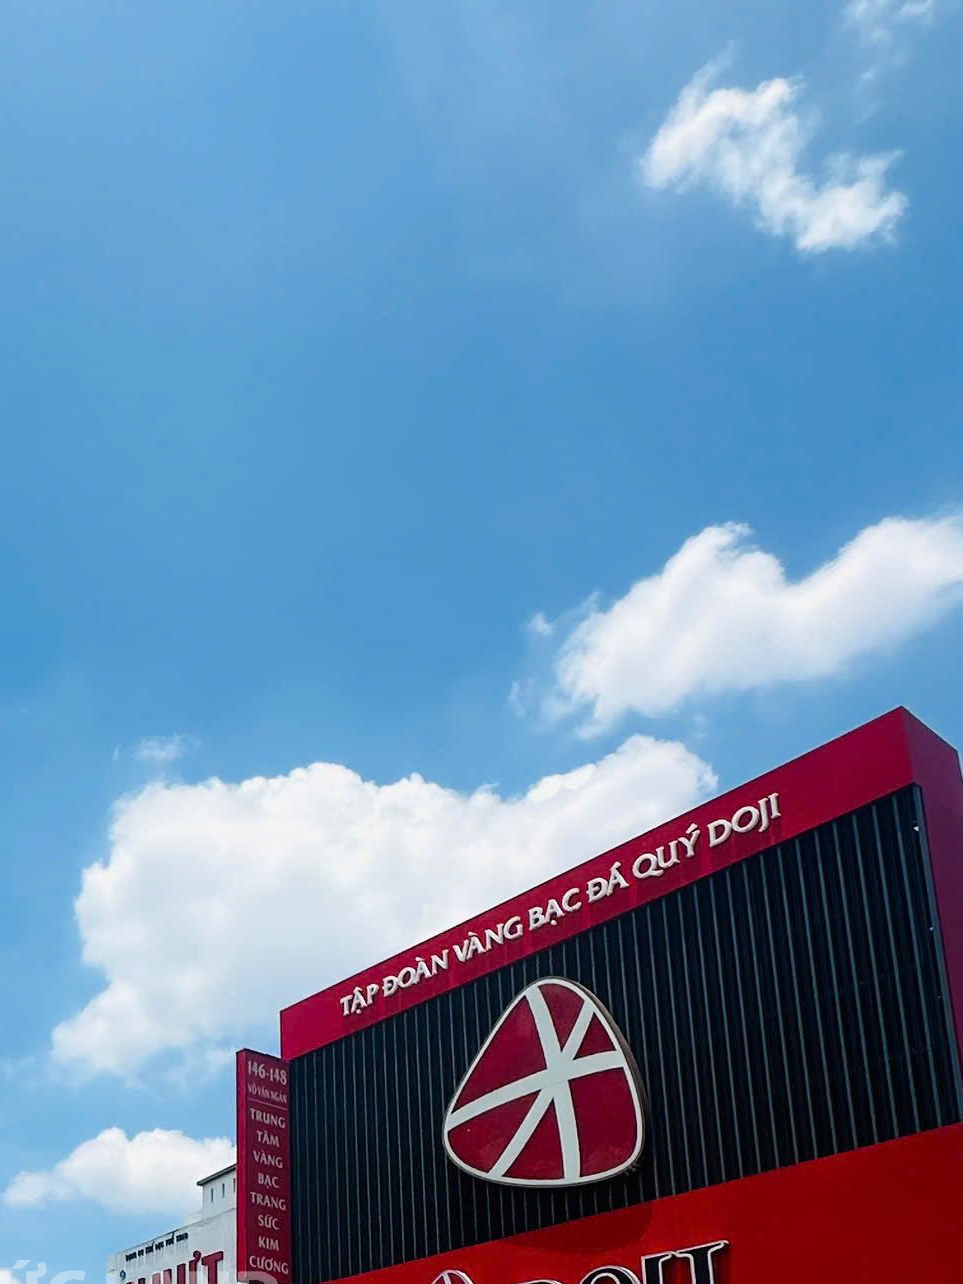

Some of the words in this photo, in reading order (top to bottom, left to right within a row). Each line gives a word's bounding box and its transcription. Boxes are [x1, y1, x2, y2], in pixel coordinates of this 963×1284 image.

[340, 988, 379, 1016] TẬP
[382, 949, 449, 998] ĐOÀN
[452, 916, 524, 963] VÀNG
[528, 887, 583, 932] BẠC
[586, 861, 629, 903] ĐÁ
[632, 822, 701, 880] QUÝ
[706, 792, 782, 848] DOJI
[247, 1061, 288, 1086] 146-148
[250, 1108, 286, 1129] TRUNG
[256, 1130, 280, 1148] TÂM
[252, 1149, 283, 1169] VÀNG
[257, 1172, 280, 1189] BẠC
[249, 1192, 287, 1211] TRANG
[257, 1214, 280, 1230] SỨC
[258, 1235, 280, 1251] KIM
[248, 1255, 289, 1275] CƯƠNG
